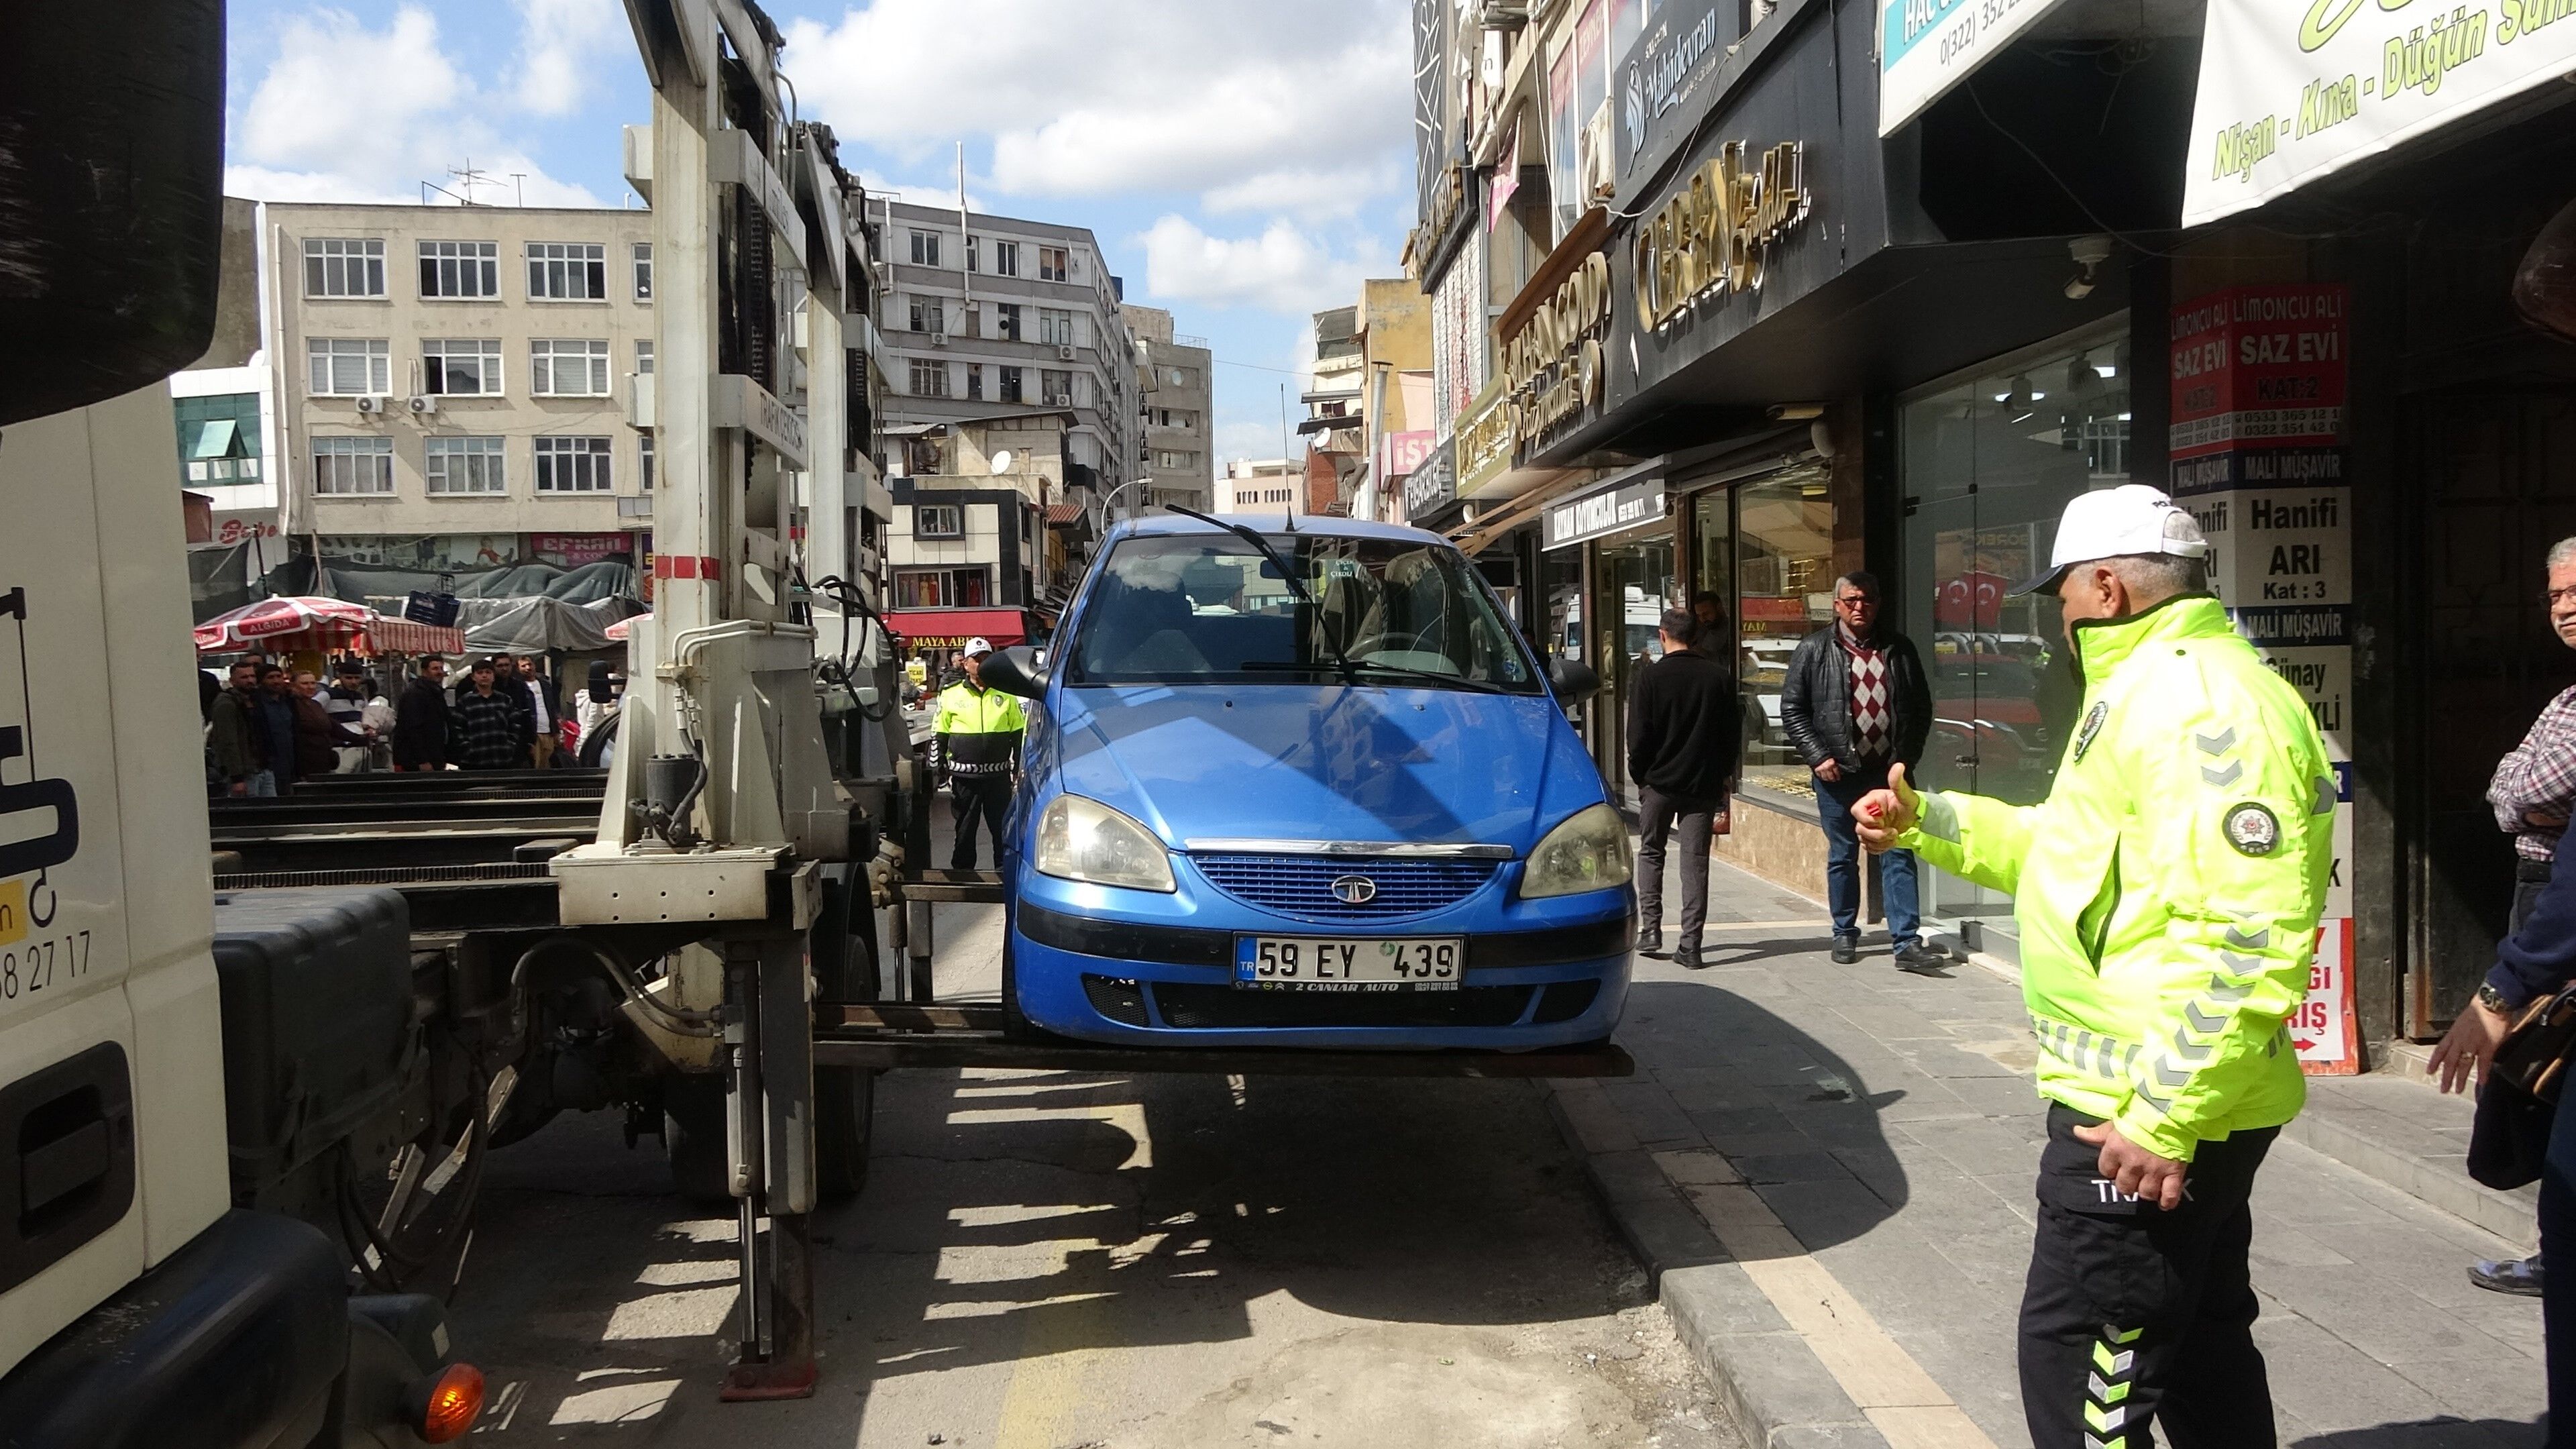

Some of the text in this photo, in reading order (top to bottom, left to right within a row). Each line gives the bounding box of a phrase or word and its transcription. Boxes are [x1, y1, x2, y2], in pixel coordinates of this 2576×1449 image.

[1941, 11, 1976, 65] 0(322)
[2212, 114, 2275, 182] Nişan
[2296, 74, 2357, 140] Kına
[2382, 5, 2487, 100] Düğün
[2233, 290, 2341, 323] LİMONCU ALİ
[2174, 331, 2226, 380] SAZ EVİ
[2240, 323, 2339, 365] SAZ EVİ
[2245, 425, 2277, 436] 0322
[2245, 448, 2341, 485] MALİ MÜŞAVİR
[2182, 501, 2227, 533] anifi
[2251, 497, 2337, 529] Hanifi
[2268, 544, 2320, 576] ARI
[2263, 582, 2297, 600] Kat
[2315, 581, 2326, 598] 3
[912, 637, 946, 647] MAYA
[2247, 608, 2342, 643] MALİ MÜŞAVİR
[0, 929, 90, 999] 8 27 17
[1240, 942, 1454, 978] TR 59 EY 439
[1362, 982, 1399, 991] AUTO
